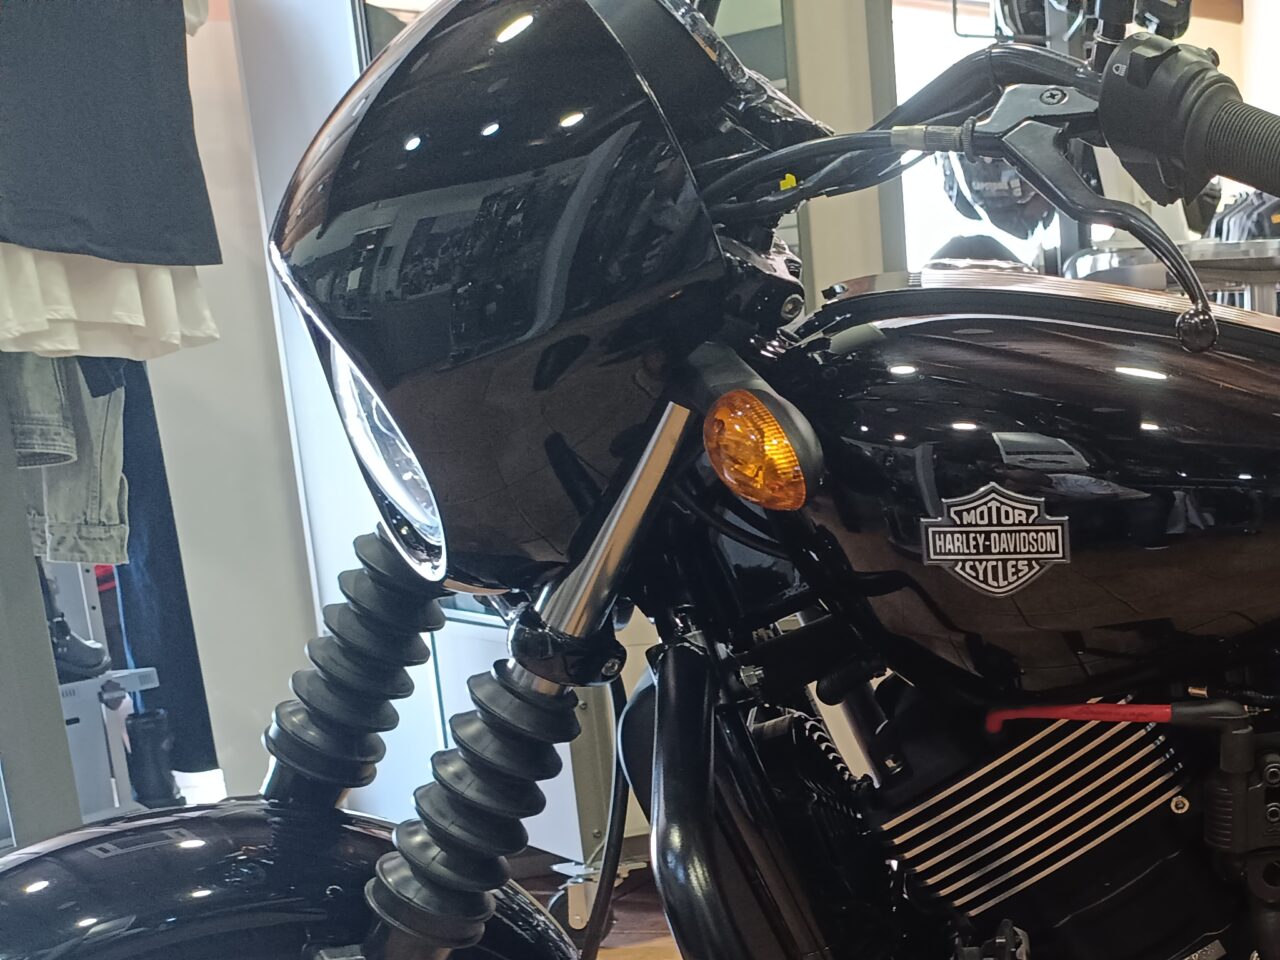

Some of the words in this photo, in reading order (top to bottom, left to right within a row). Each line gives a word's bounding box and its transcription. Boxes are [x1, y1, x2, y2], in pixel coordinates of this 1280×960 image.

[962, 500, 1027, 525] MOTOR
[935, 531, 1056, 554] HARLEY-DAVIDSON
[965, 560, 1029, 587] CYCLES
